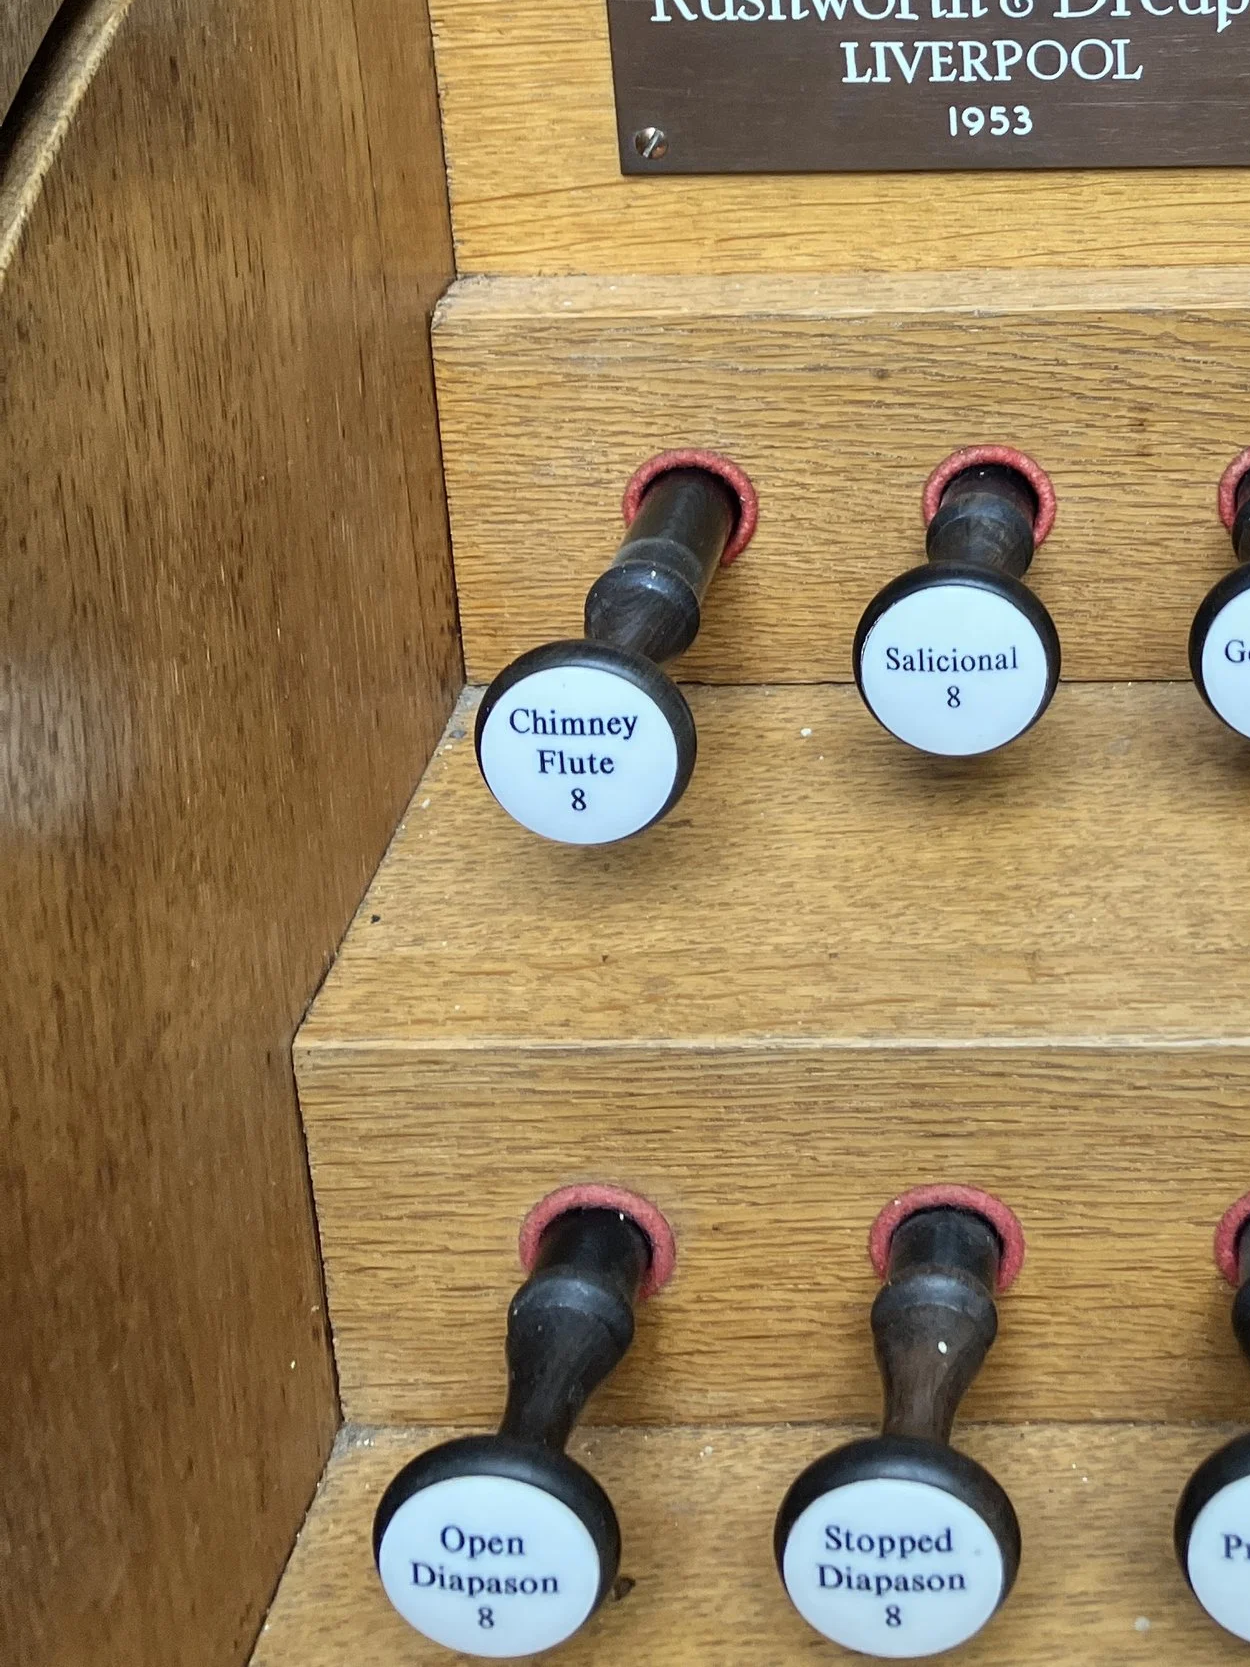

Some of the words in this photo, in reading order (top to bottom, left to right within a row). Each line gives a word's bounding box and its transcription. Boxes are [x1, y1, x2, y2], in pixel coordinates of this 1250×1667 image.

[839, 38, 1144, 84] LIVERPOOL
[948, 105, 1033, 137] 1953
[886, 646, 1018, 673] Salicional
[946, 685, 961, 709] 8
[509, 708, 638, 741] Chimney
[537, 749, 615, 775] Flute
[570, 787, 587, 812] 8
[440, 1525, 525, 1559] Open
[824, 1525, 954, 1560] Stopped
[412, 1562, 558, 1598] Diapason
[818, 1564, 966, 1597] Diapason
[477, 1606, 495, 1629] 8
[885, 1605, 902, 1627] 8
